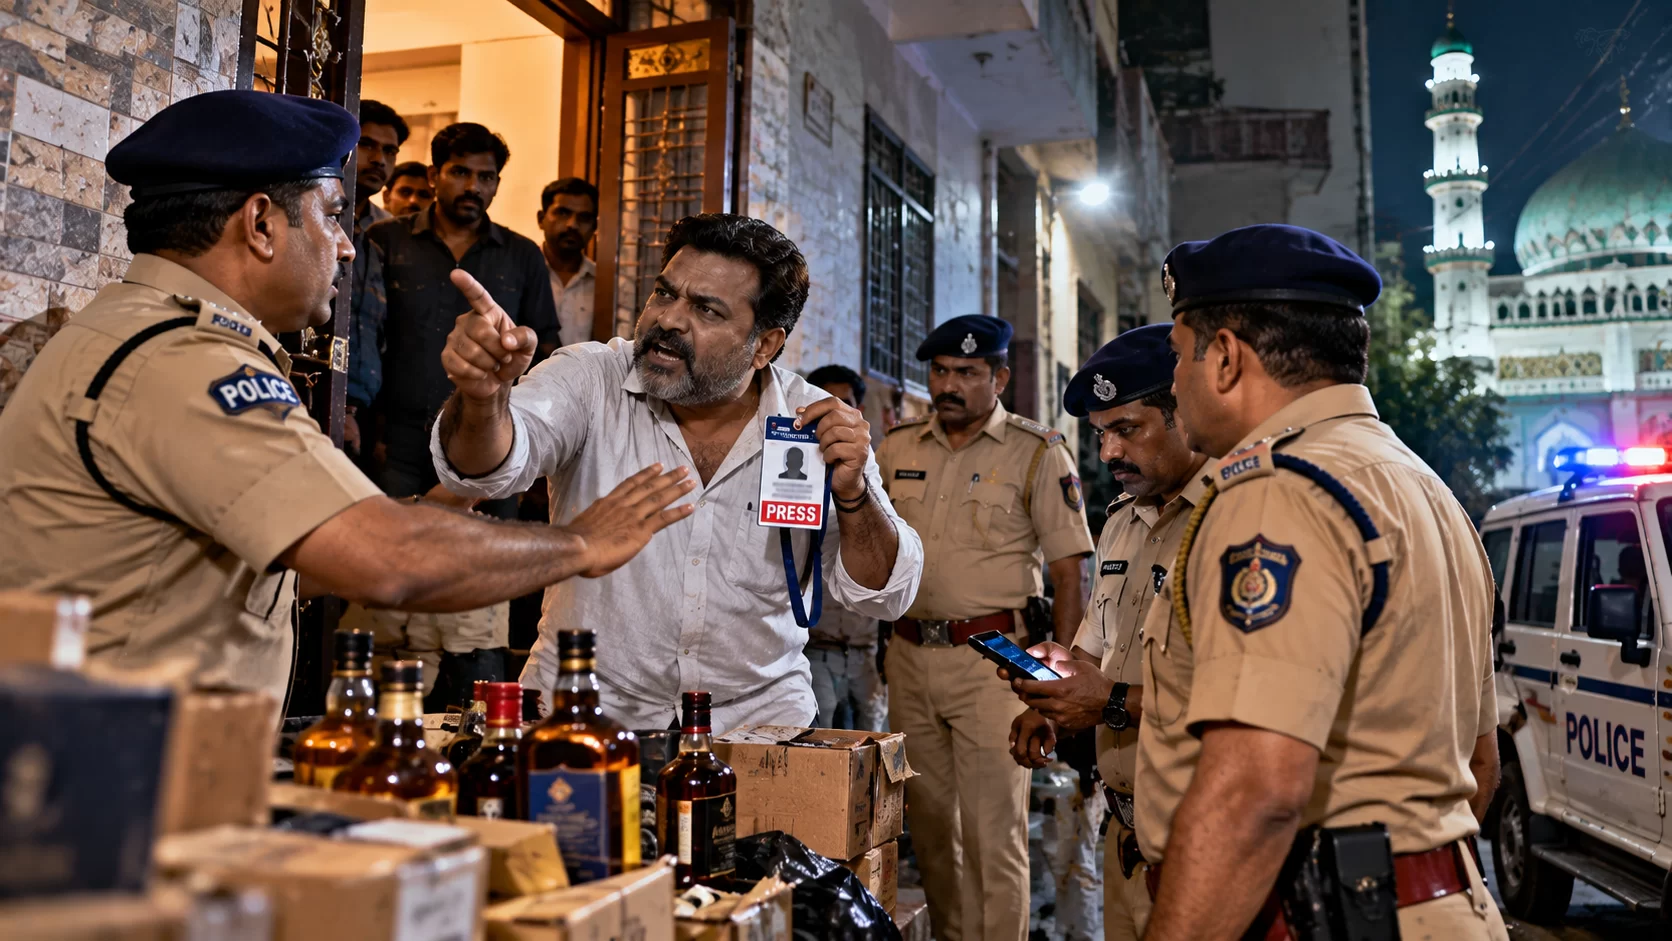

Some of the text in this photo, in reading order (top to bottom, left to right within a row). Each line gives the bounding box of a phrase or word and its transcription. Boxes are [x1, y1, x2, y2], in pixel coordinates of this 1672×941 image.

[220, 378, 297, 408] POLICE
[766, 504, 816, 522] PRESS
[1566, 711, 1646, 779] POLICE
